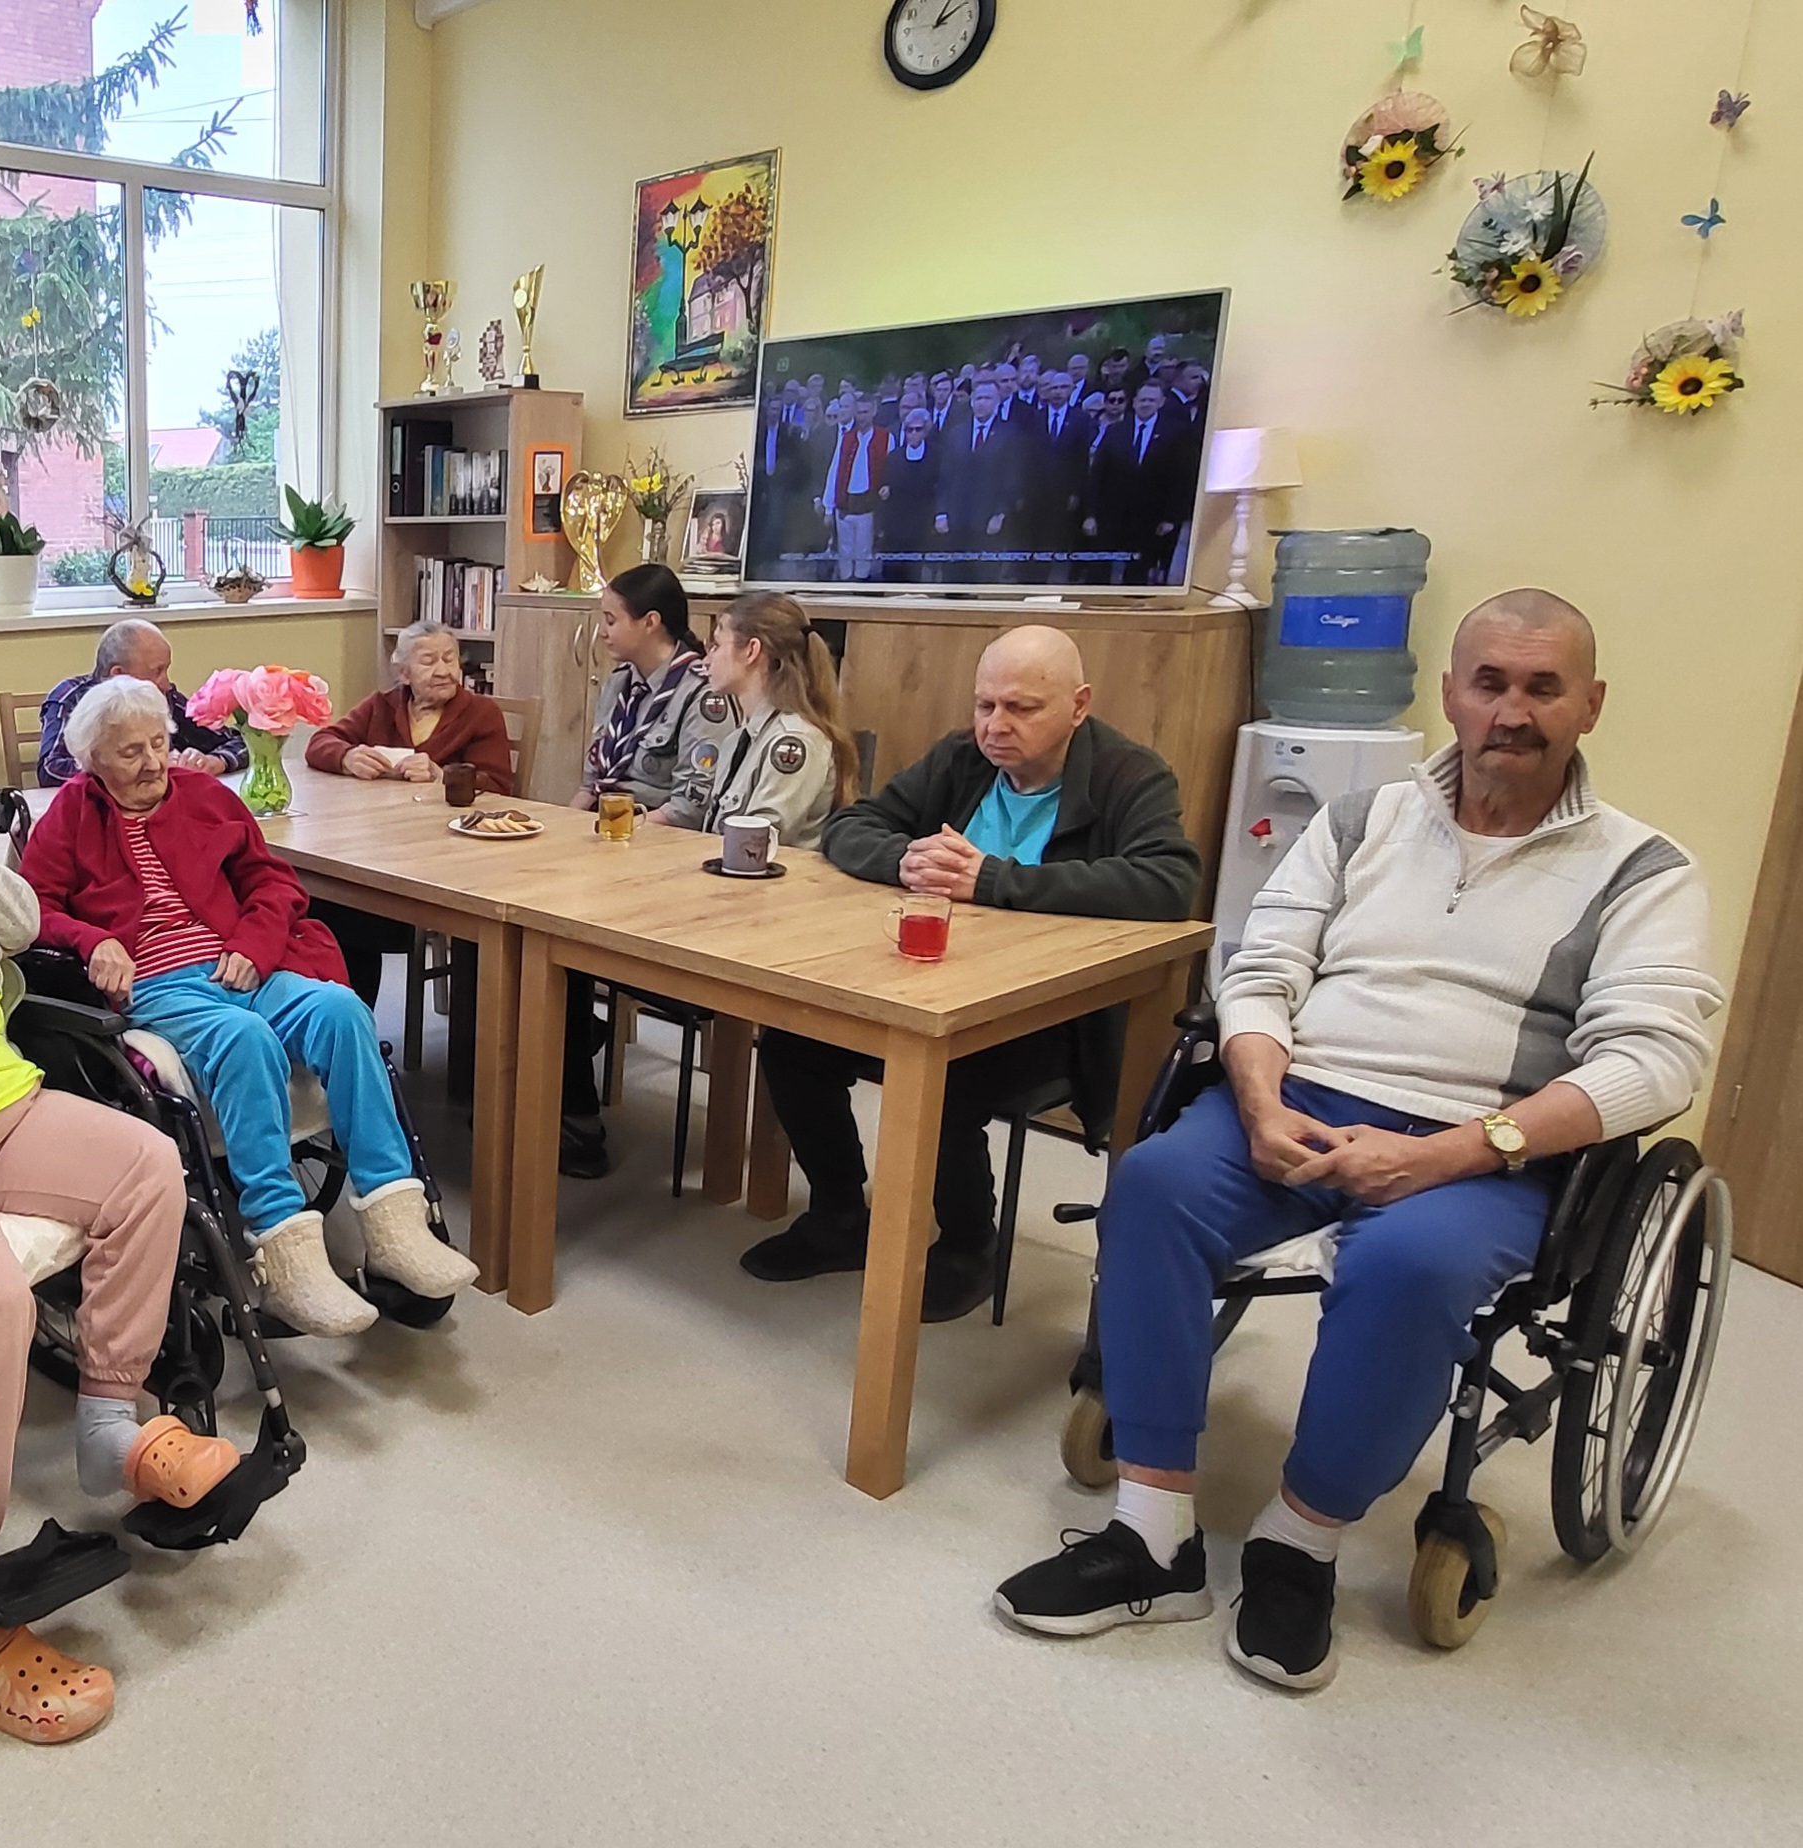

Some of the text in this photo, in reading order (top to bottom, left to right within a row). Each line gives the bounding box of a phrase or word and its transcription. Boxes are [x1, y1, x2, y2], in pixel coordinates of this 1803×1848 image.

[905, 8, 917, 20] 10
[966, 10, 973, 22] 3
[903, 27, 911, 39] 9
[960, 31, 968, 42] 4
[907, 44, 913, 55] 8
[948, 45, 956, 58] 5
[932, 55, 940, 67] 6
